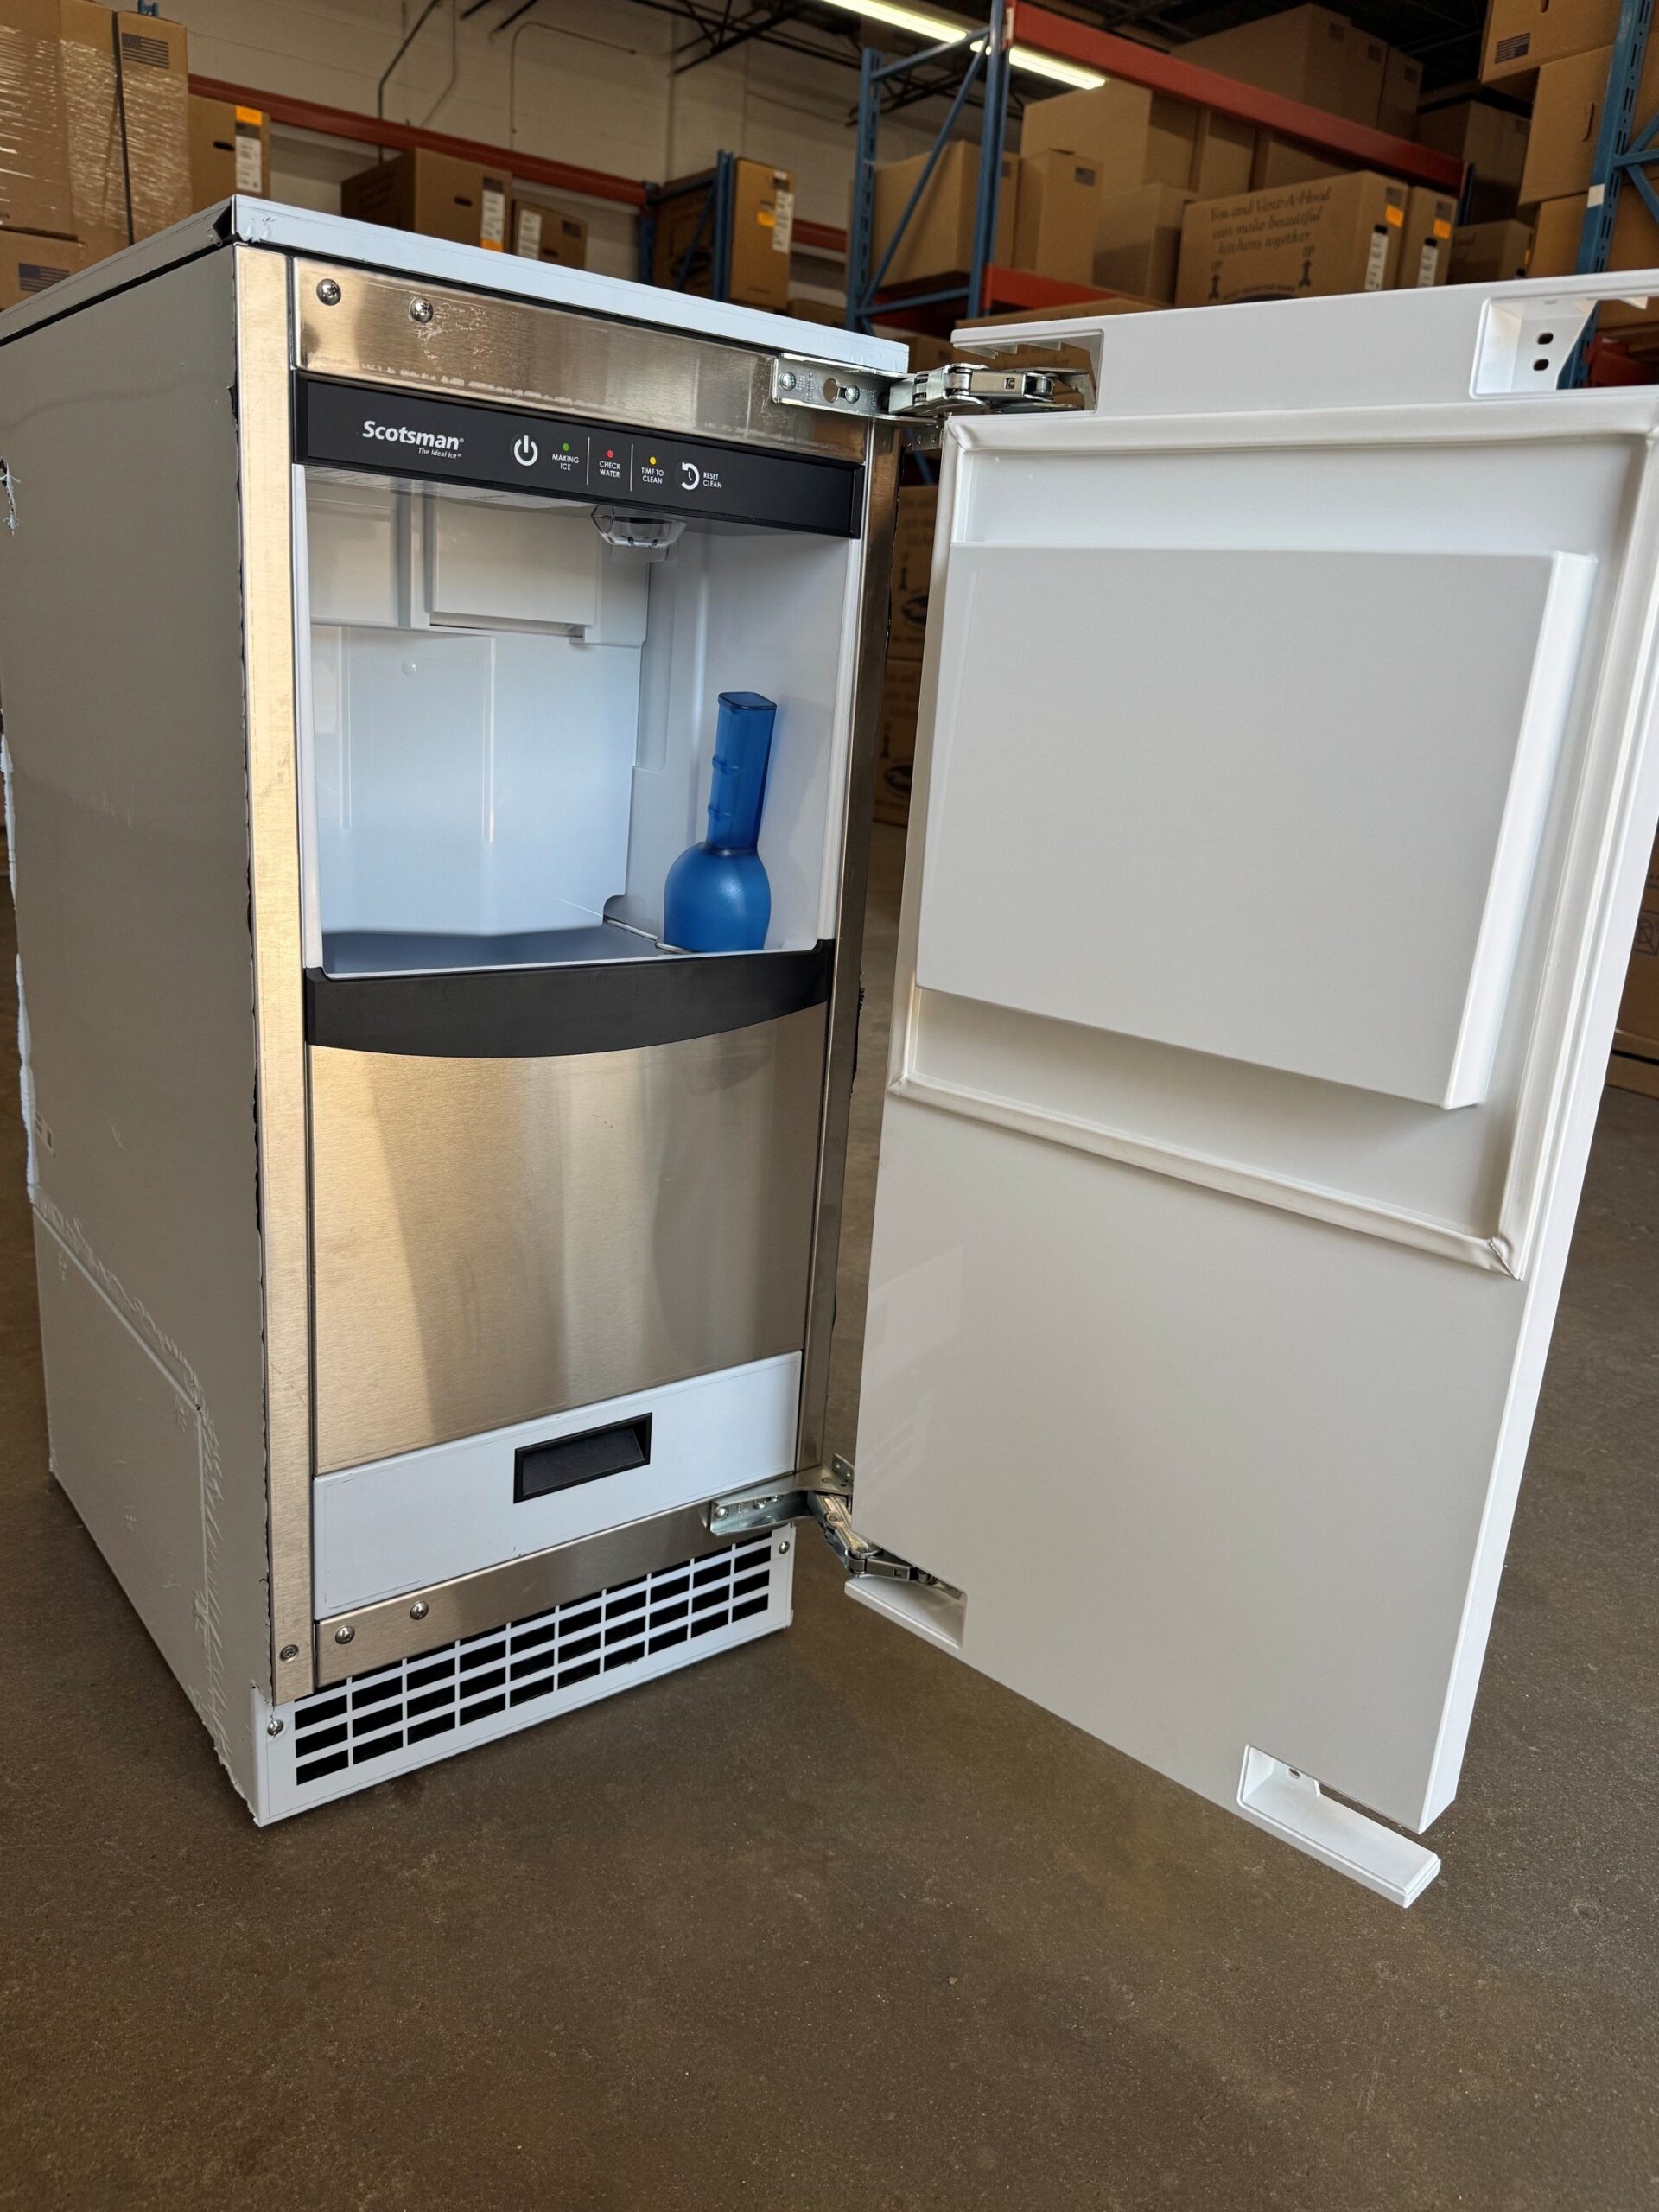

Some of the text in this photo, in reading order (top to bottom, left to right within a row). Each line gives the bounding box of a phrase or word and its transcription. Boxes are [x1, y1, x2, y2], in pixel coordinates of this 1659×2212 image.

[431, 449, 448, 458] Ideal
[551, 453, 580, 464] MAKING
[599, 461, 621, 470] CHECK
[600, 468, 620, 478] WATER
[641, 467, 664, 477] TIME TO
[703, 472, 719, 480] RESET
[642, 475, 663, 485] CLEAN
[703, 479, 722, 489] CLEAN
